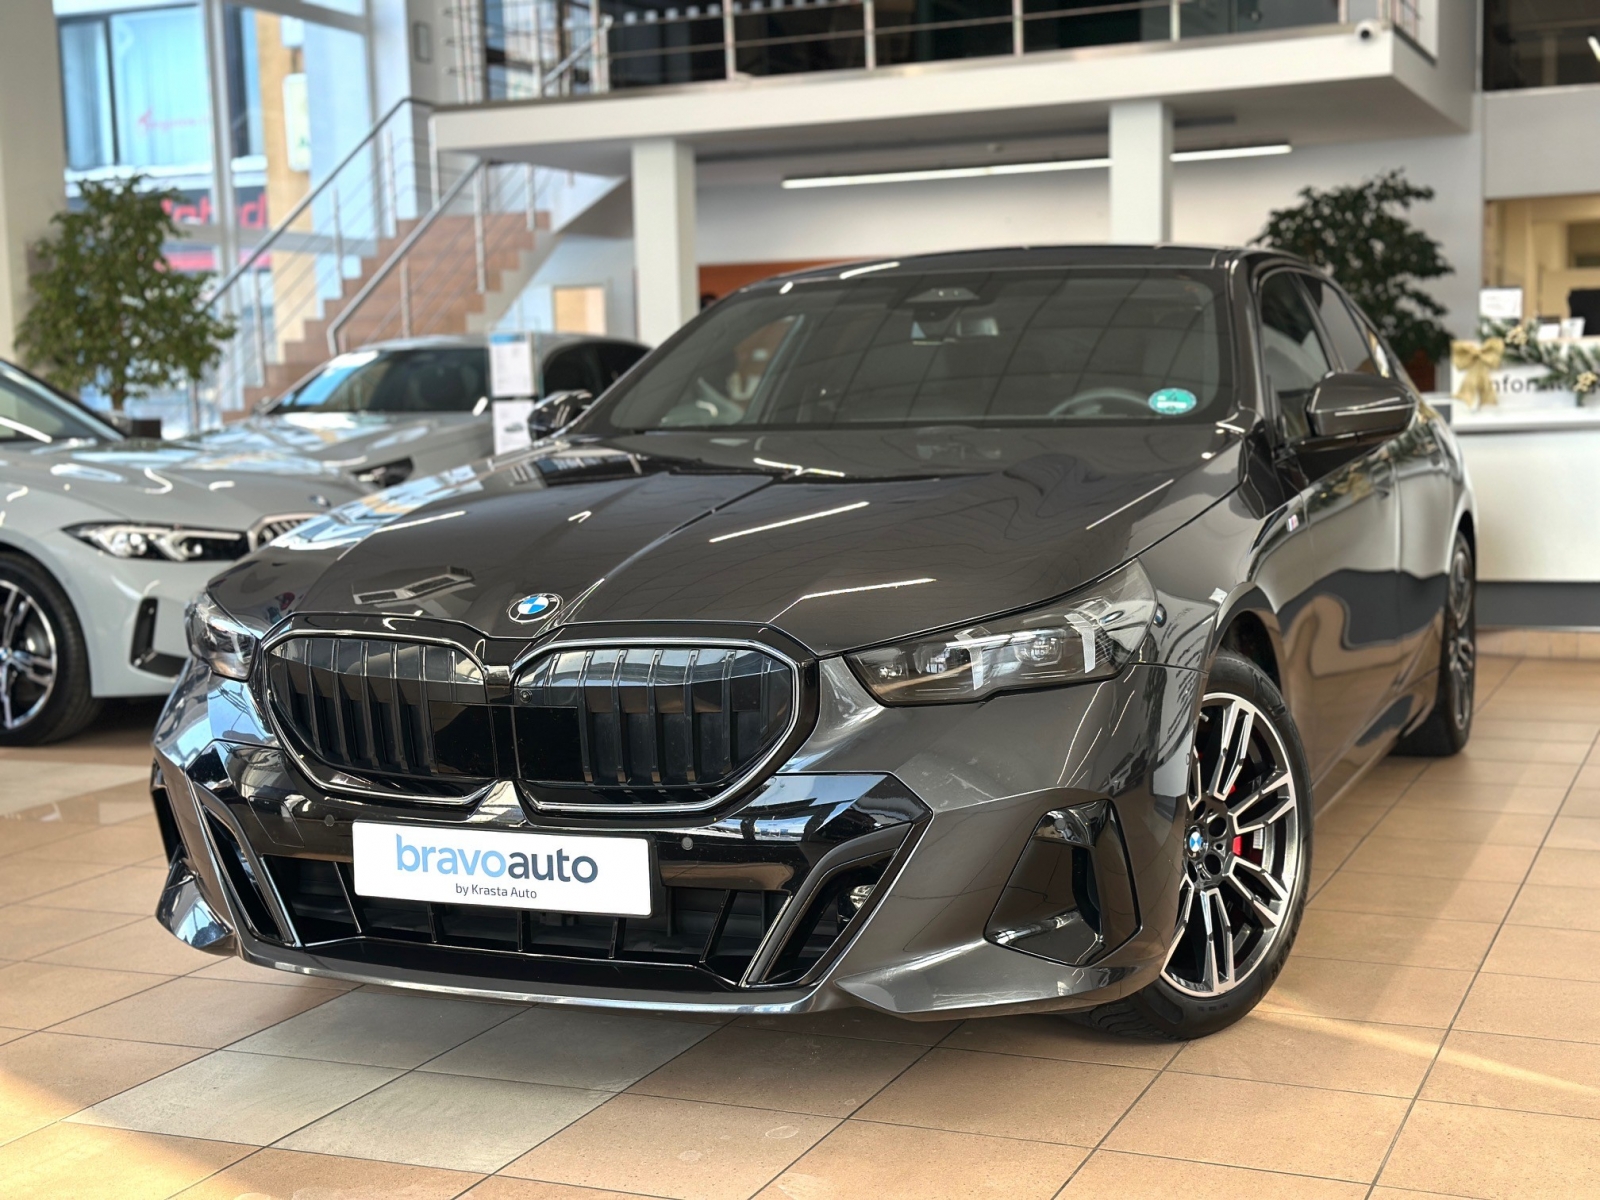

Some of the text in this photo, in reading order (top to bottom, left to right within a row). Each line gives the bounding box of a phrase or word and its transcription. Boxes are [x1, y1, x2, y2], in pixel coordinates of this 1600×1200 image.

[396, 833, 599, 884] bravoauto
[455, 883, 538, 899] by Krasta Auto
